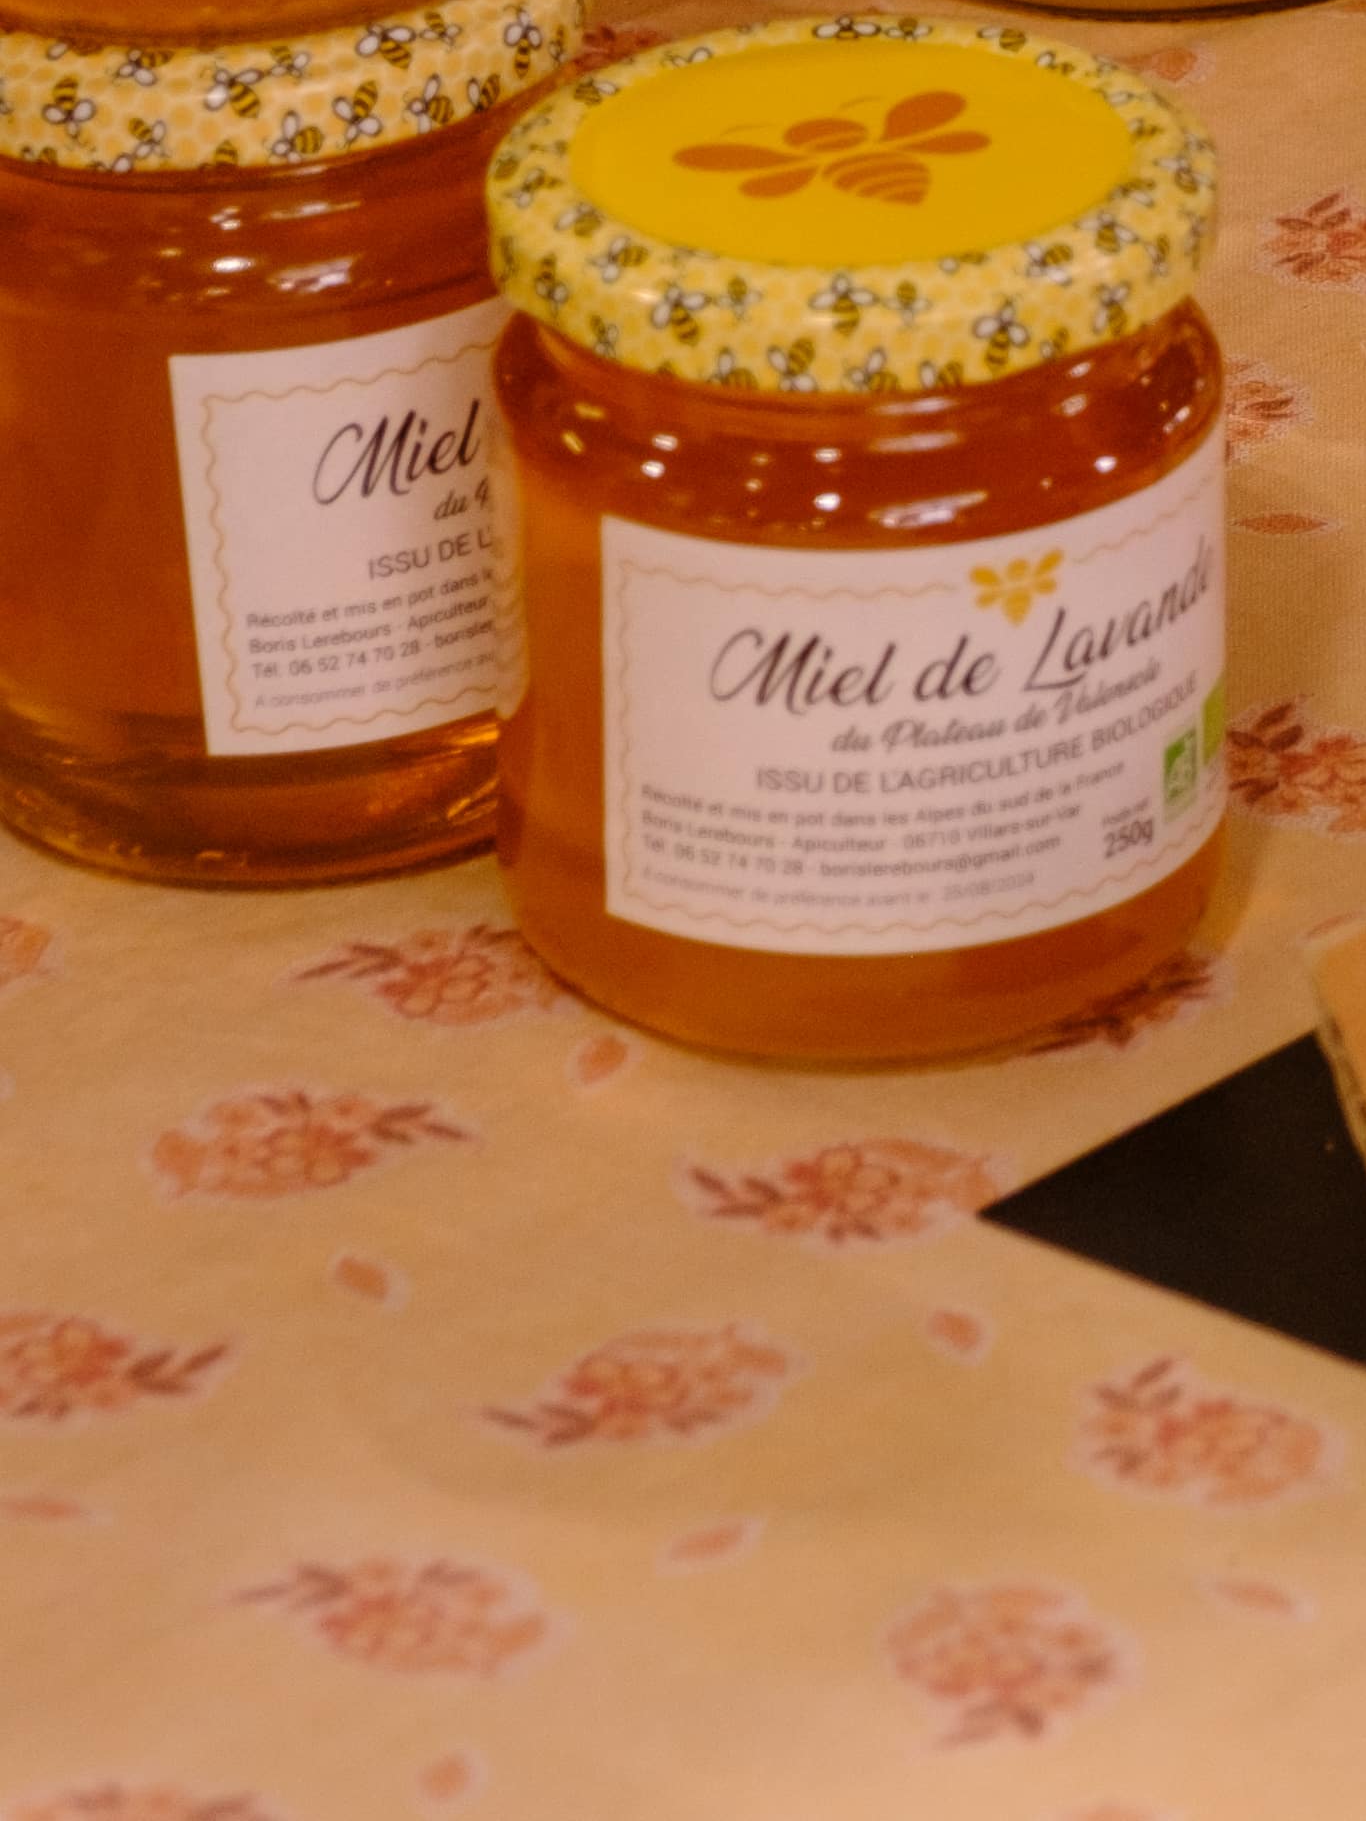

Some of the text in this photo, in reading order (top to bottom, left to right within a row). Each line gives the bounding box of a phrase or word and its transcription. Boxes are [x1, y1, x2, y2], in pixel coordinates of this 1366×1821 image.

[313, 398, 481, 506] Miel
[432, 491, 469, 522] du
[367, 532, 472, 580] ISSU DE
[712, 628, 897, 714] Miel
[912, 634, 995, 703] de
[755, 670, 1196, 797] ISSU DE L'AGRICULTURE BIOLOGIQUE
[1012, 704, 1049, 734] de
